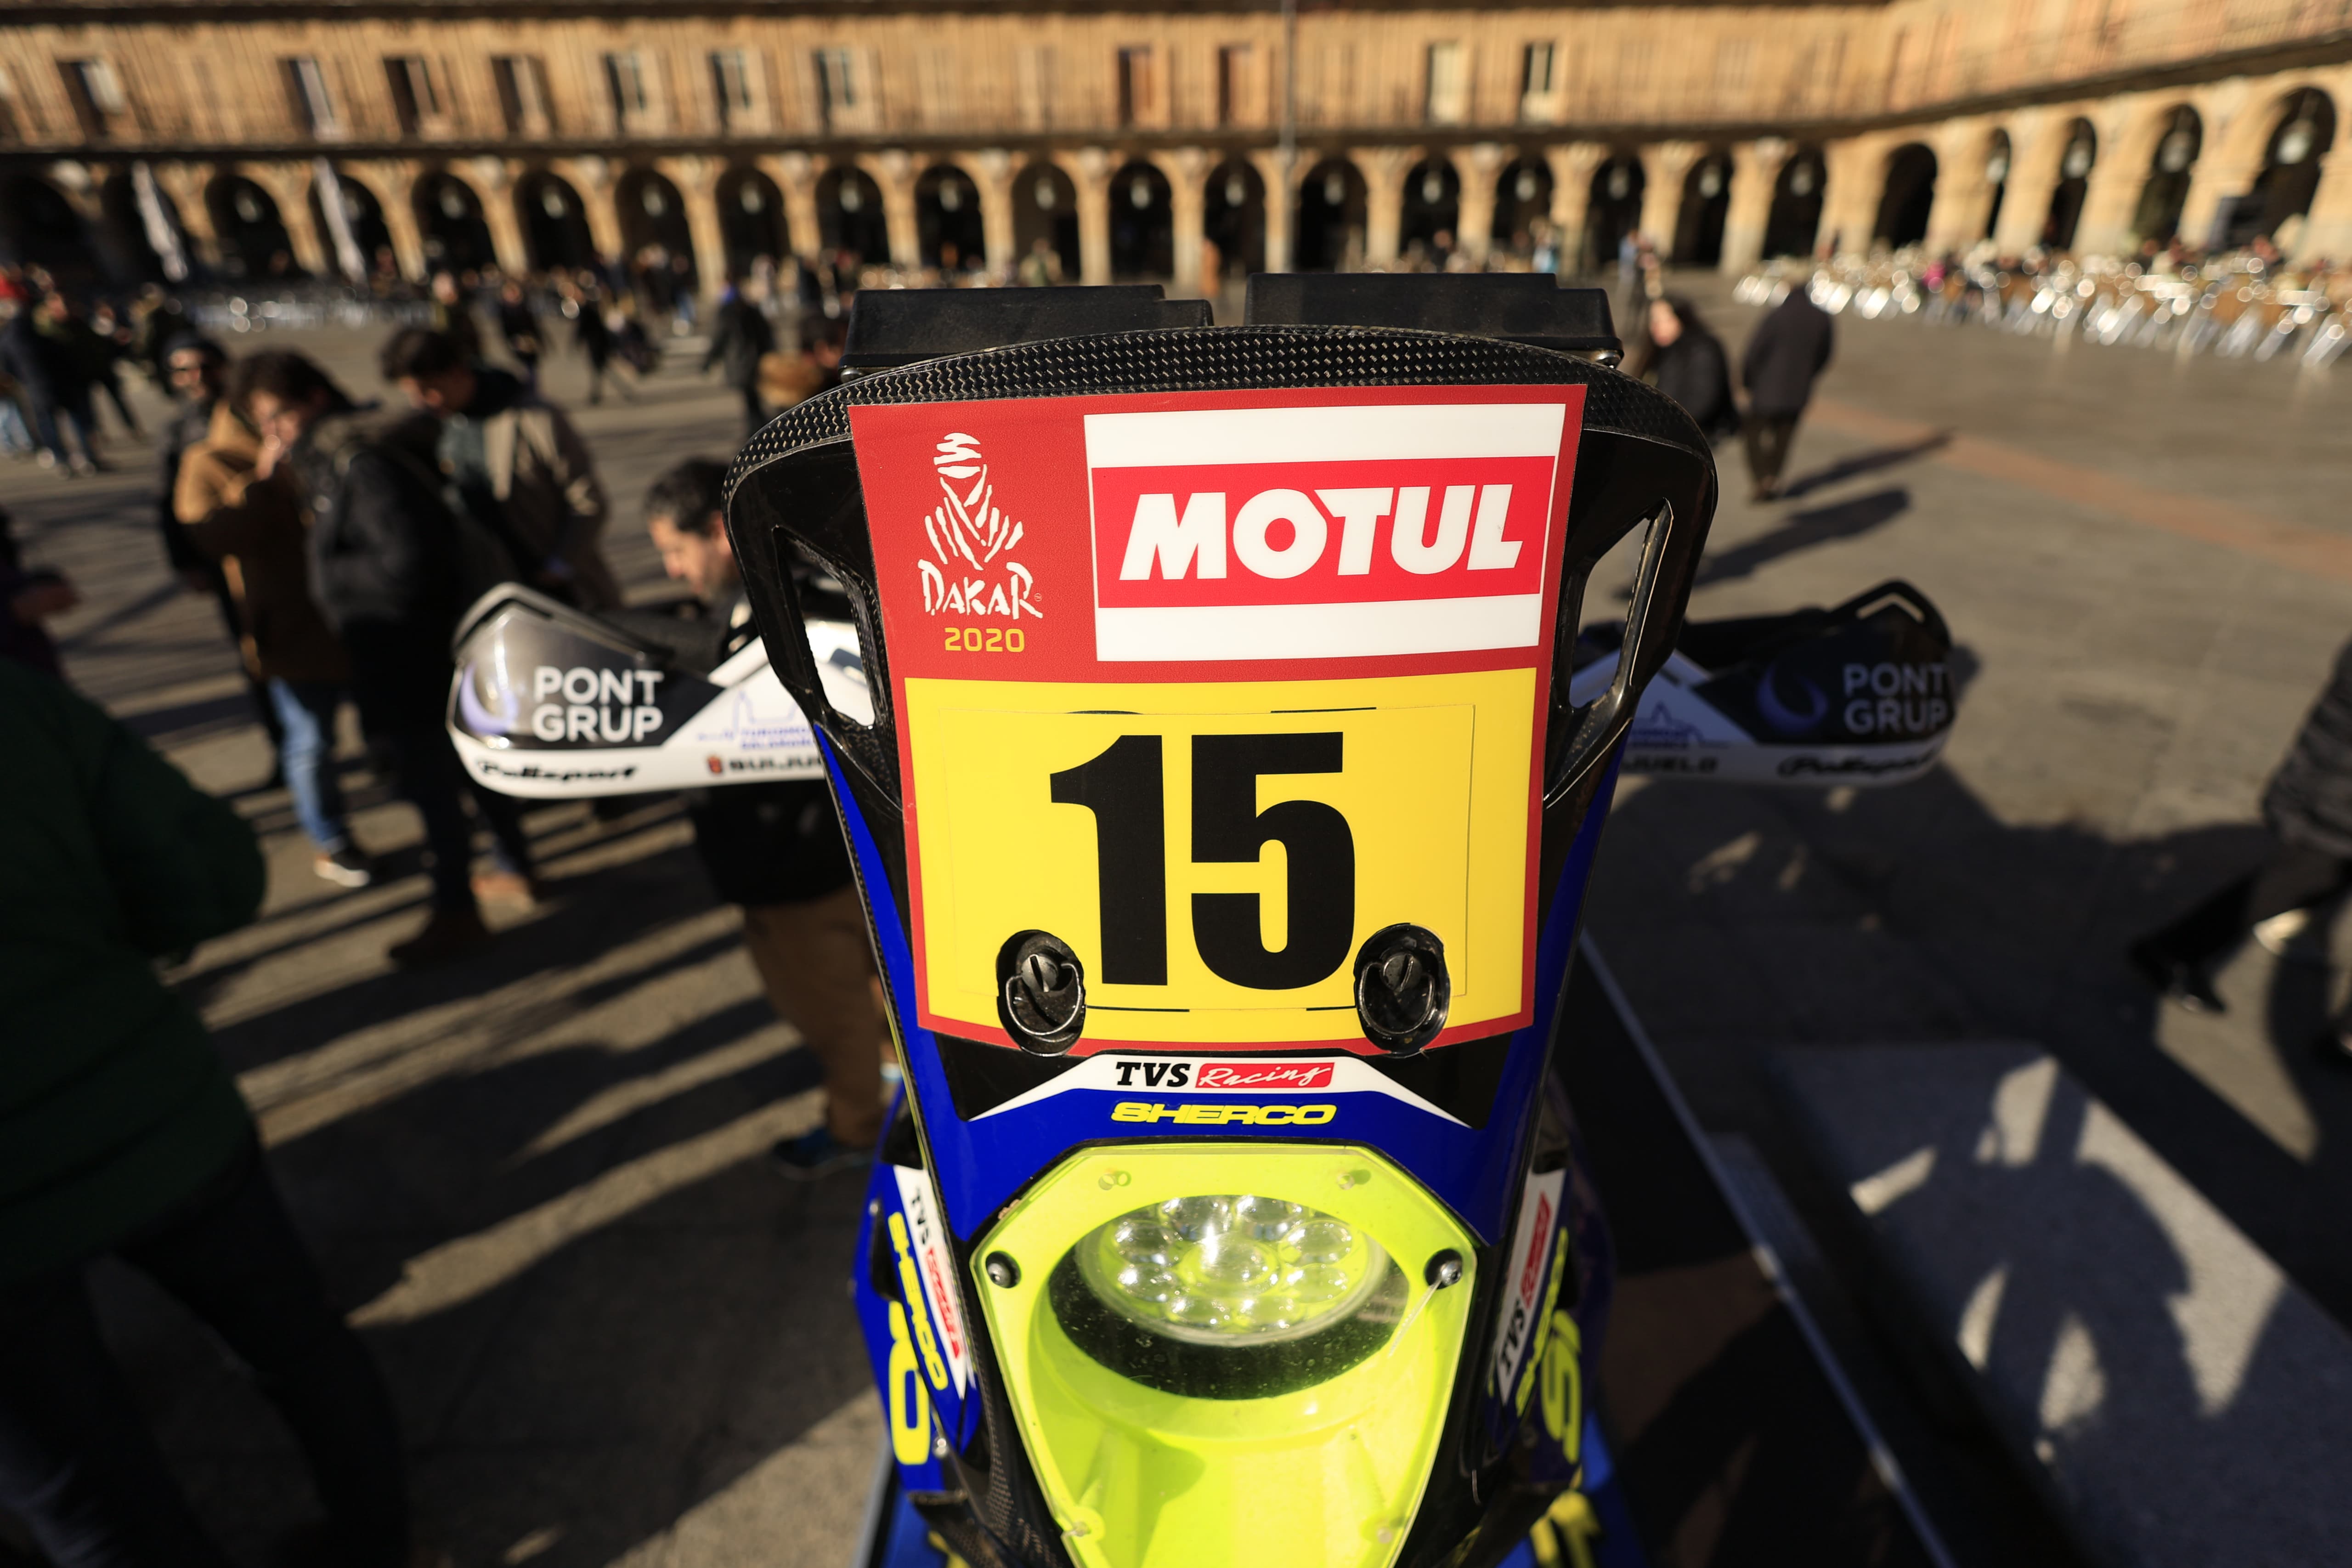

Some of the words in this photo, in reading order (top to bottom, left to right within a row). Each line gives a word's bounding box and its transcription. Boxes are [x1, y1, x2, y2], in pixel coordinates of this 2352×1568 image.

[1119, 483, 1523, 581] MOTUL
[918, 559, 1043, 619] DAKAR
[944, 627, 1025, 652] 2020
[533, 666, 664, 705] PONT
[1842, 662, 1947, 698] PONT
[531, 703, 664, 743] GRUP
[1843, 696, 1948, 735] GRUP
[1049, 731, 1356, 991] 15
[1115, 1062, 1192, 1087] TVS
[1199, 1065, 1331, 1087] Racing
[1110, 1101, 1338, 1125] SHERCO
